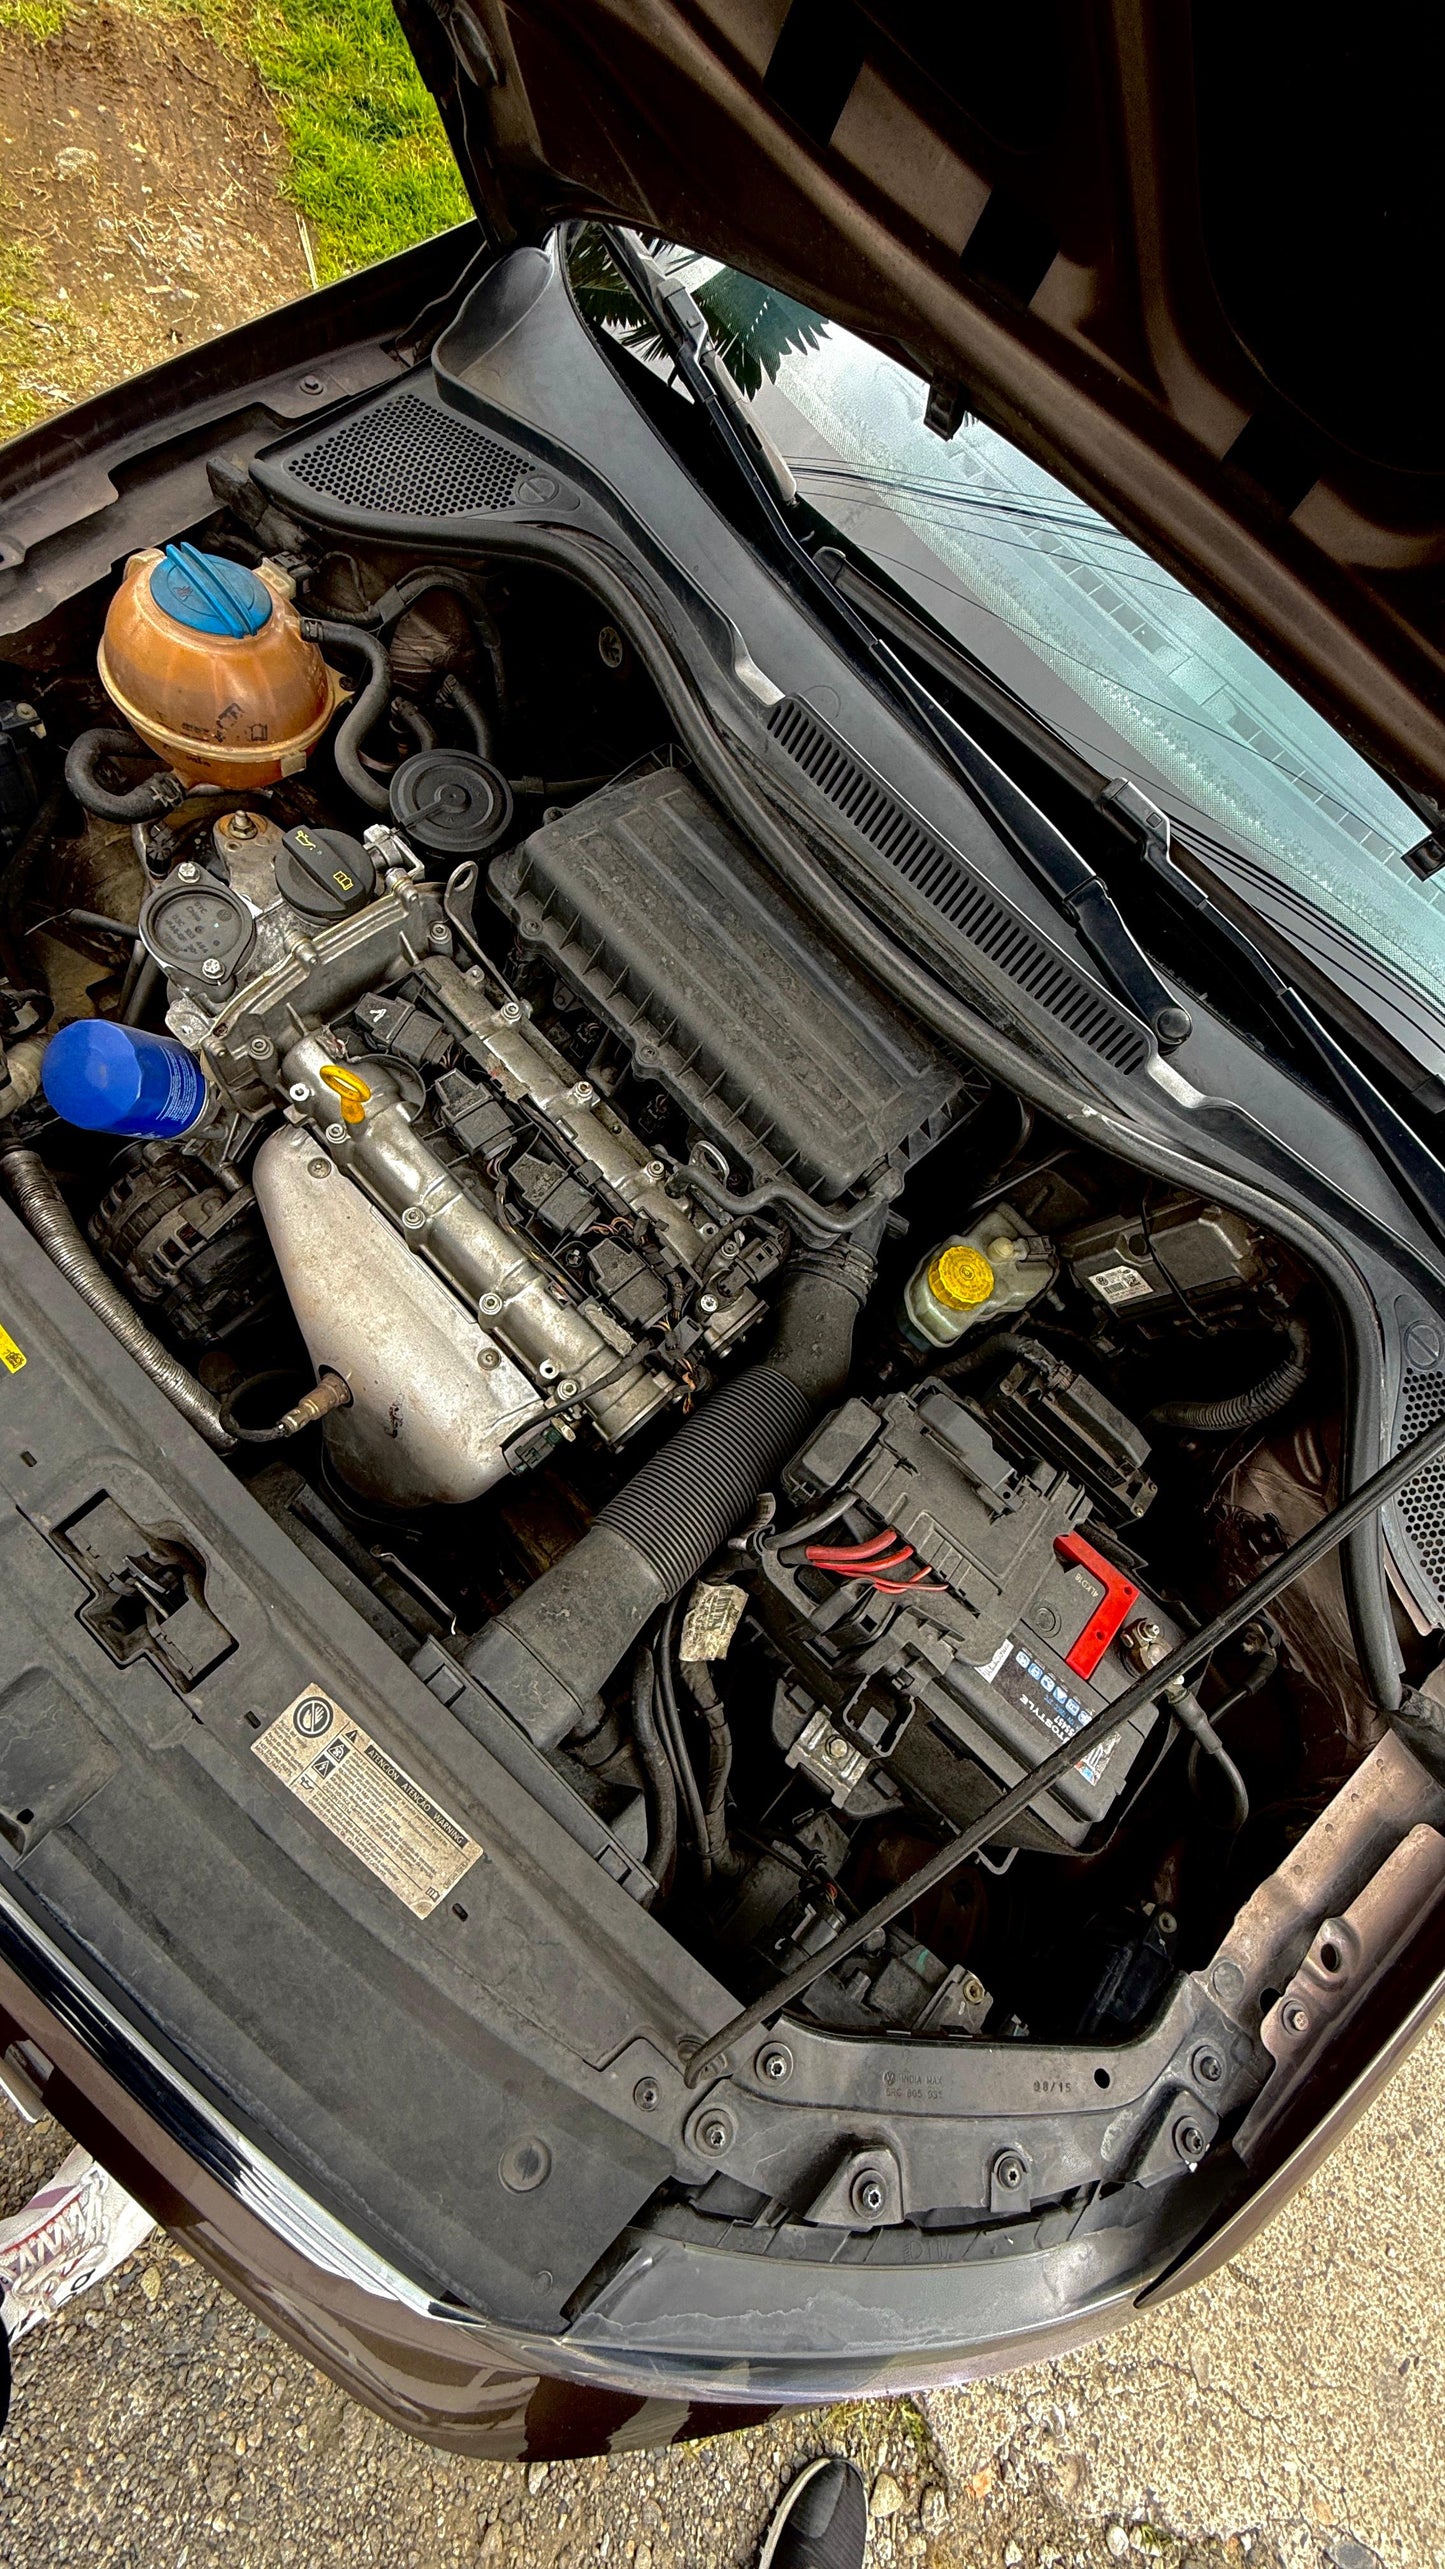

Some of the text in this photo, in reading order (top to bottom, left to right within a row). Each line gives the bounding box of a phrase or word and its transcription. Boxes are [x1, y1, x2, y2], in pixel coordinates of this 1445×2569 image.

[1053, 1715, 1076, 1738] 55457
[367, 1747, 400, 1781] ATENCIÓN
[400, 1780, 433, 1813] ATENÇÃO
[431, 1812, 464, 1844] WARNING
